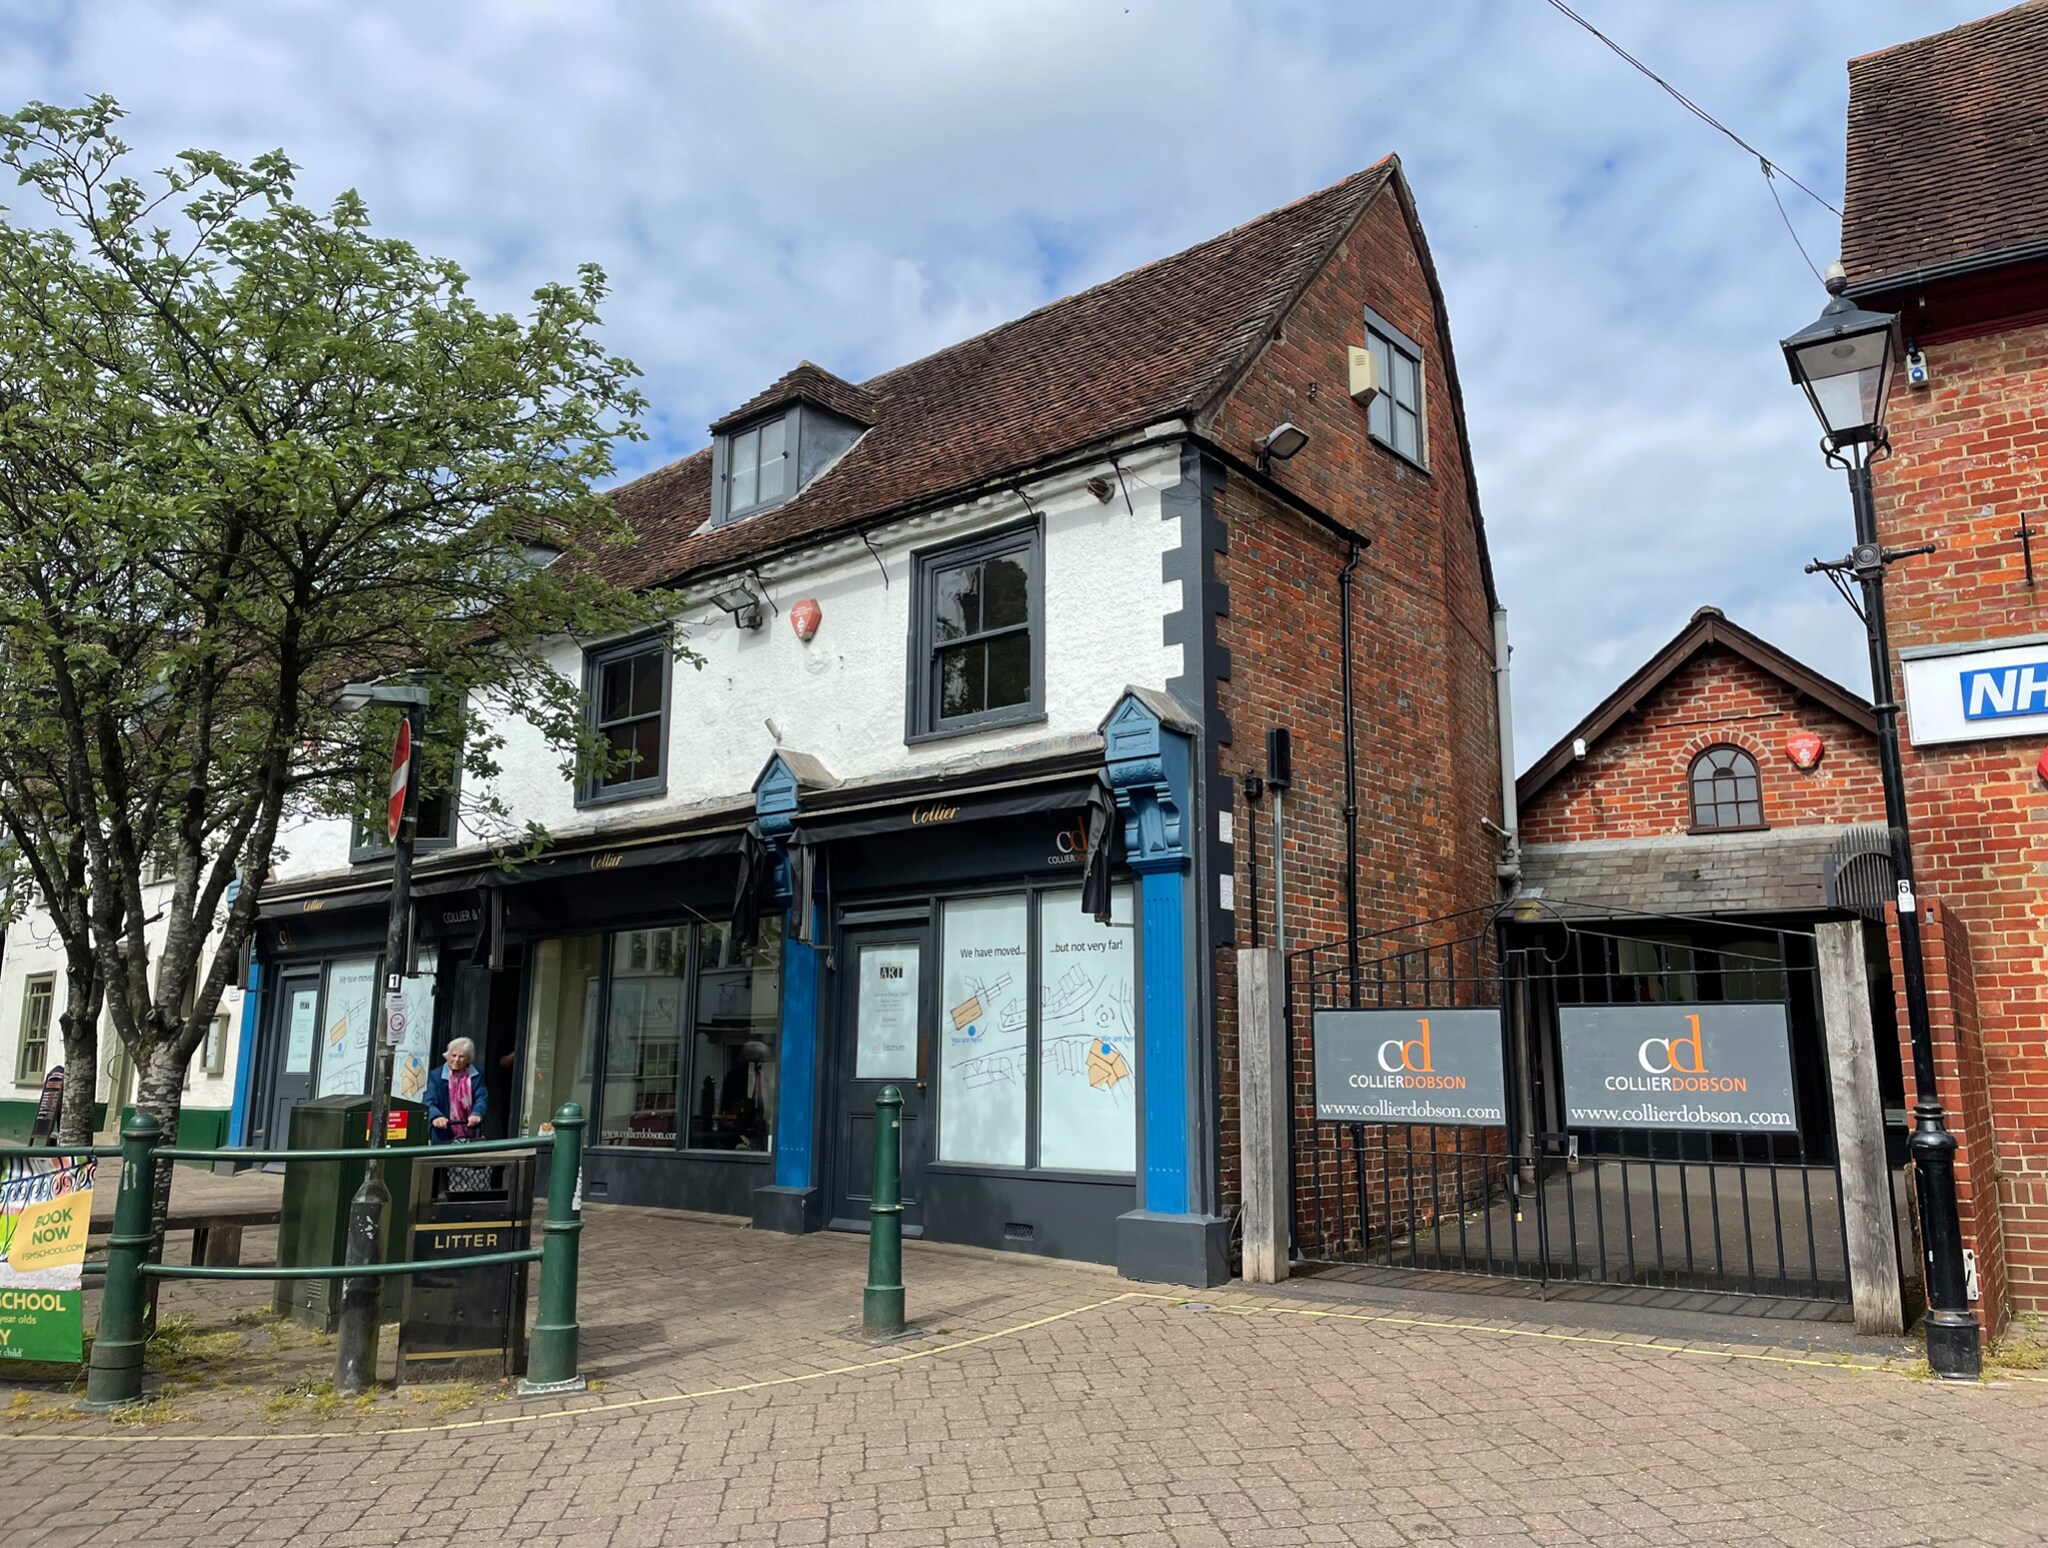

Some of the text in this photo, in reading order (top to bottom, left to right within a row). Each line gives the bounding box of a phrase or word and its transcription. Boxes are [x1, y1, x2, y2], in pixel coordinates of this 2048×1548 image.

[911, 802, 960, 825] Collier
[590, 852, 623, 870] Collier
[1900, 881, 1909, 894] 6
[443, 909, 478, 924] COLLIER &
[960, 949, 973, 958] We
[974, 947, 992, 958] have
[1071, 942, 1086, 952] not
[1088, 943, 1106, 953] very
[1108, 940, 1123, 950] far!
[391, 975, 399, 987] 1
[880, 966, 903, 979] ART
[1377, 1017, 1436, 1073] cd
[1638, 1014, 1710, 1075] cd
[1349, 1075, 1466, 1090] COLLIERDOBSON
[1605, 1076, 1747, 1093] COLLIERDOBSON
[1320, 1099, 1501, 1119] www.collierdobson.com
[1571, 1103, 1792, 1126] www.collierdobson.com
[34, 1207, 73, 1229] BOOK
[32, 1225, 71, 1246] NOW
[434, 1233, 498, 1249] LITTER
[0, 1291, 66, 1312] CHOOL
[18, 1315, 37, 1325] olds
